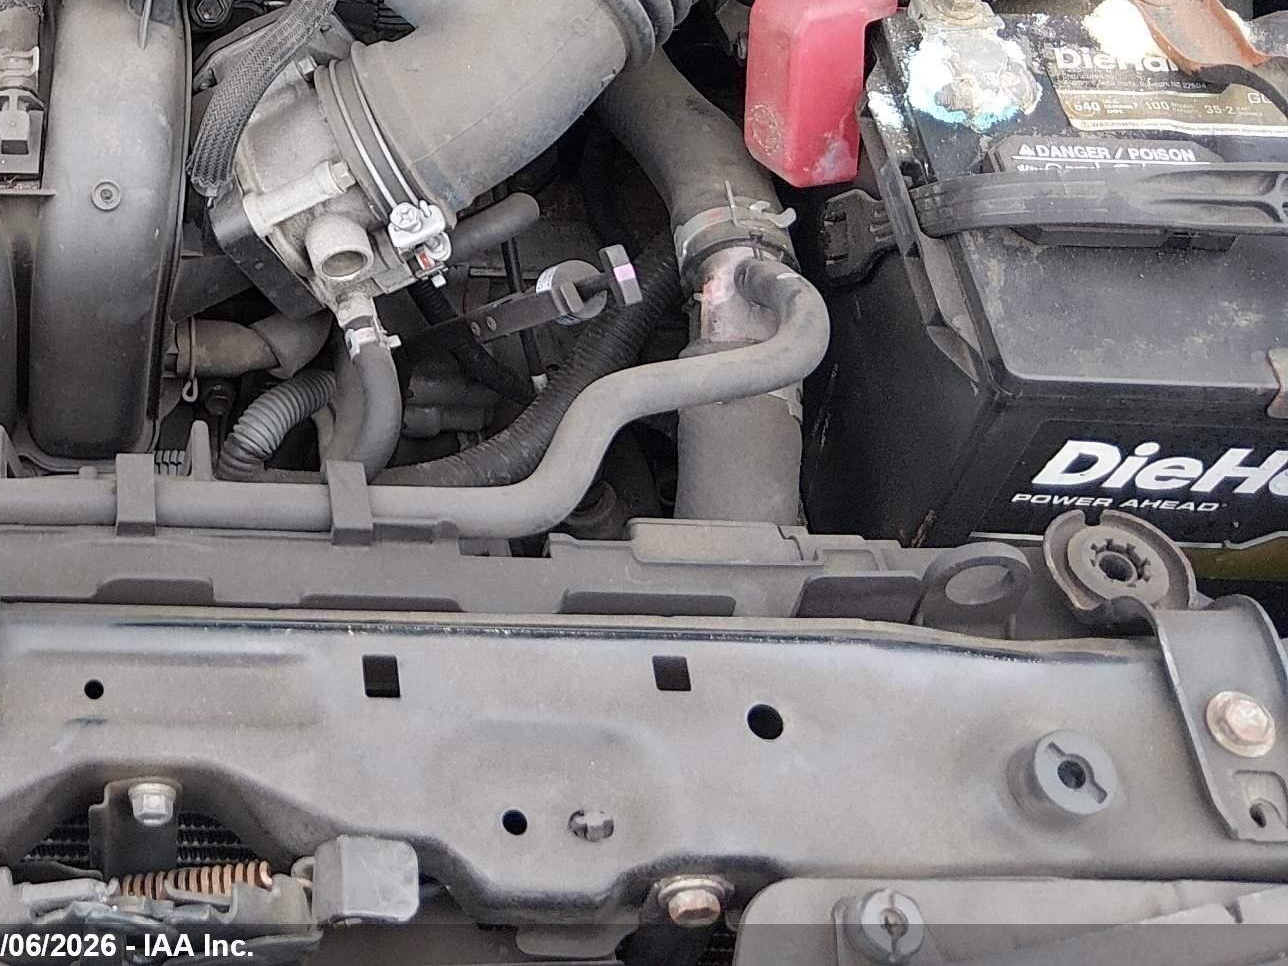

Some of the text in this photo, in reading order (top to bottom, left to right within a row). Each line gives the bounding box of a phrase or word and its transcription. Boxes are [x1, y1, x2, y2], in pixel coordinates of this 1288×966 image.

[1036, 144, 1111, 160] DANGER
[1128, 147, 1196, 162] POISON
[1011, 493, 1221, 512] POWER AHEAD
